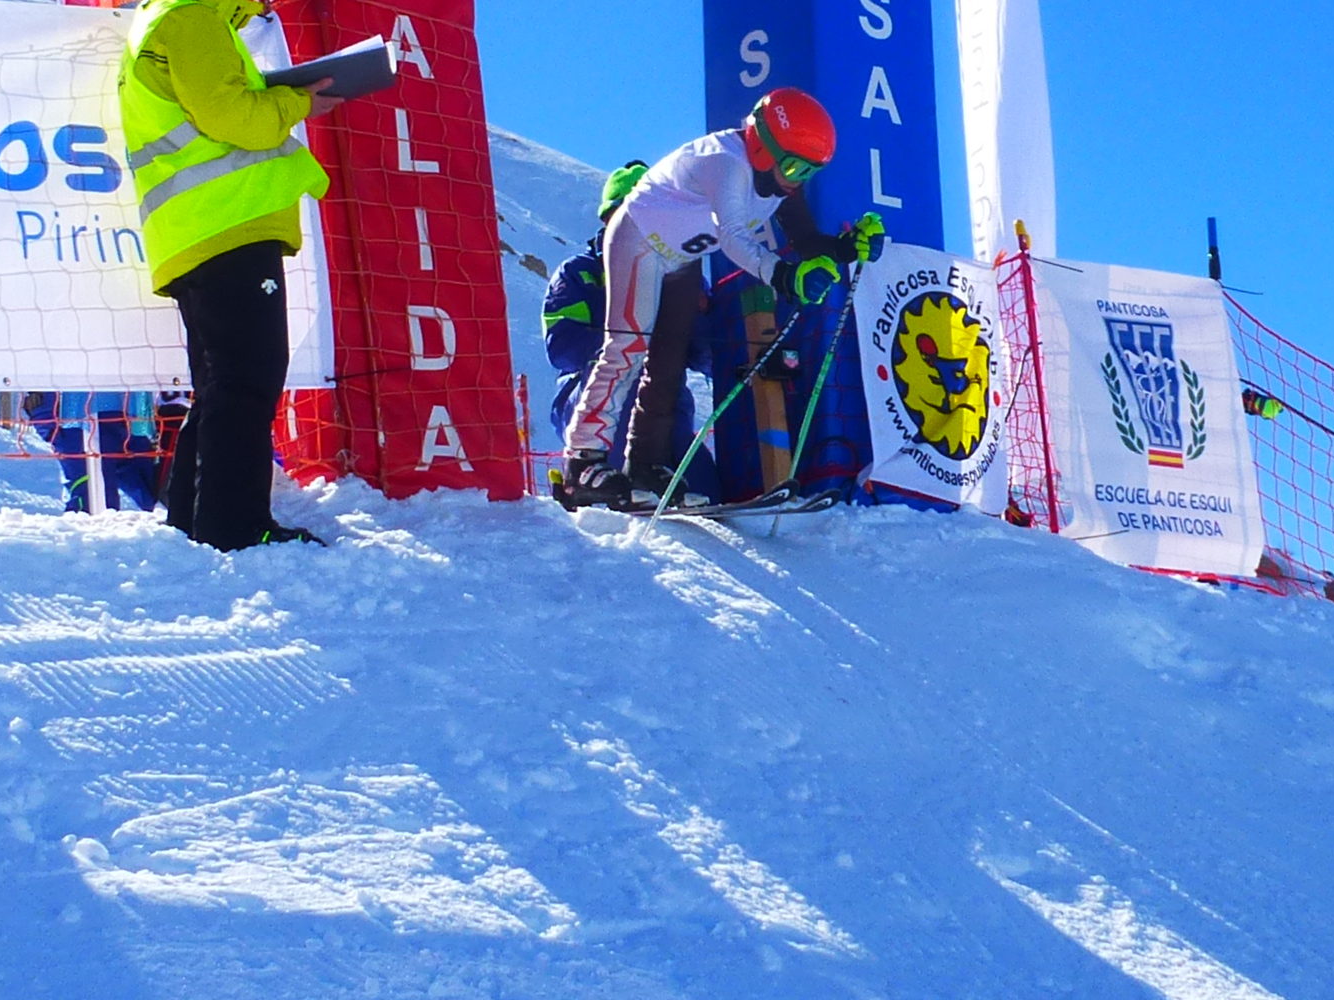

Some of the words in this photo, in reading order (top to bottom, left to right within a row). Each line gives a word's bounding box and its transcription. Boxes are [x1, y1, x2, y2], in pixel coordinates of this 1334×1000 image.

[681, 233, 718, 254] 6
[872, 269, 941, 353] Panticosa
[1096, 299, 1170, 319] PANTICOSA
[1094, 484, 1165, 506] ESCUELA
[1167, 491, 1188, 509] DE
[1190, 493, 1233, 514] ESQUI
[1117, 511, 1141, 529] DE
[1141, 513, 1224, 537] PANTICOSA
